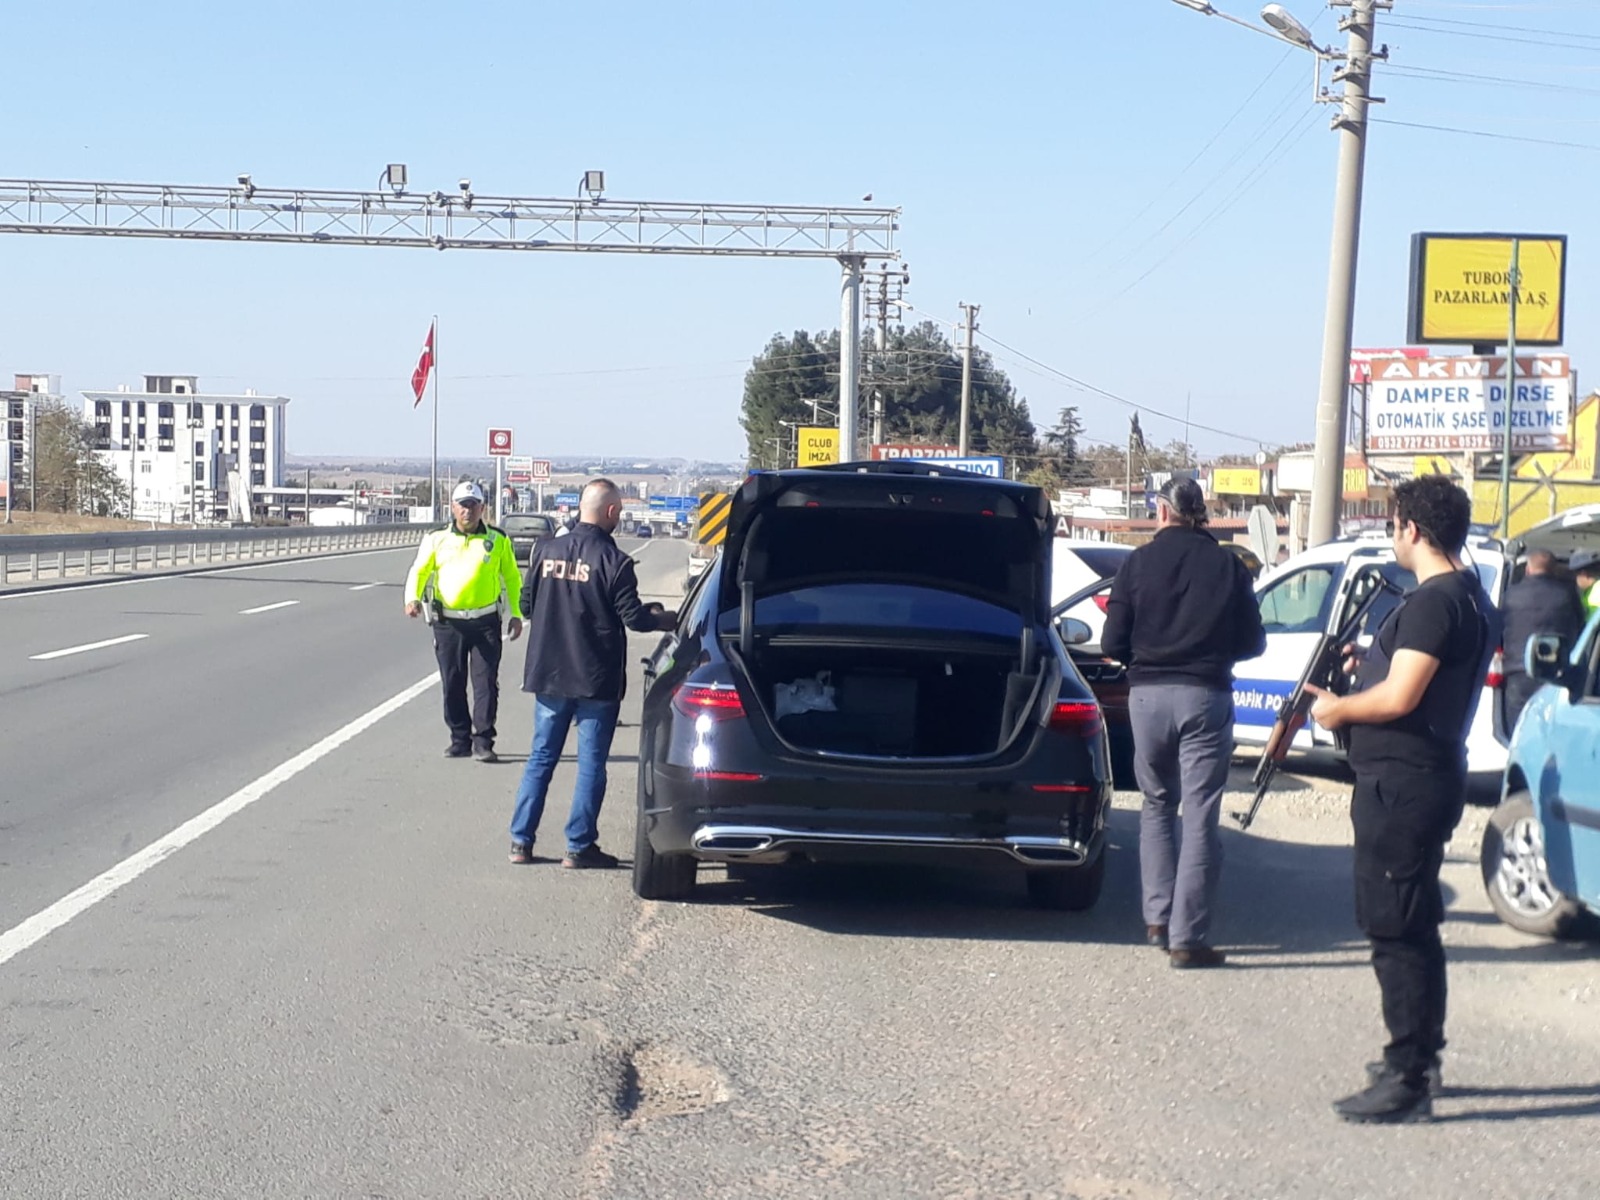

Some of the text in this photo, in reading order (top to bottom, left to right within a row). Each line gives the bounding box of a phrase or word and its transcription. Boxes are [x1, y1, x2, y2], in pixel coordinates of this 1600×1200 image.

[1434, 289, 1523, 305] PAZARLAMA
[1381, 359, 1562, 378] AKMAN
[1387, 387, 1470, 403] DAMPER
[1490, 386, 1555, 402] DRSE
[1377, 407, 1446, 429] OTOMATİK
[1452, 412, 1487, 431] ŞASE
[807, 438, 832, 448] CLUB
[1378, 436, 1402, 450] 0532
[808, 452, 831, 462] İMZA
[542, 558, 590, 582] POLİS
[1233, 689, 1263, 709] RAFİK
